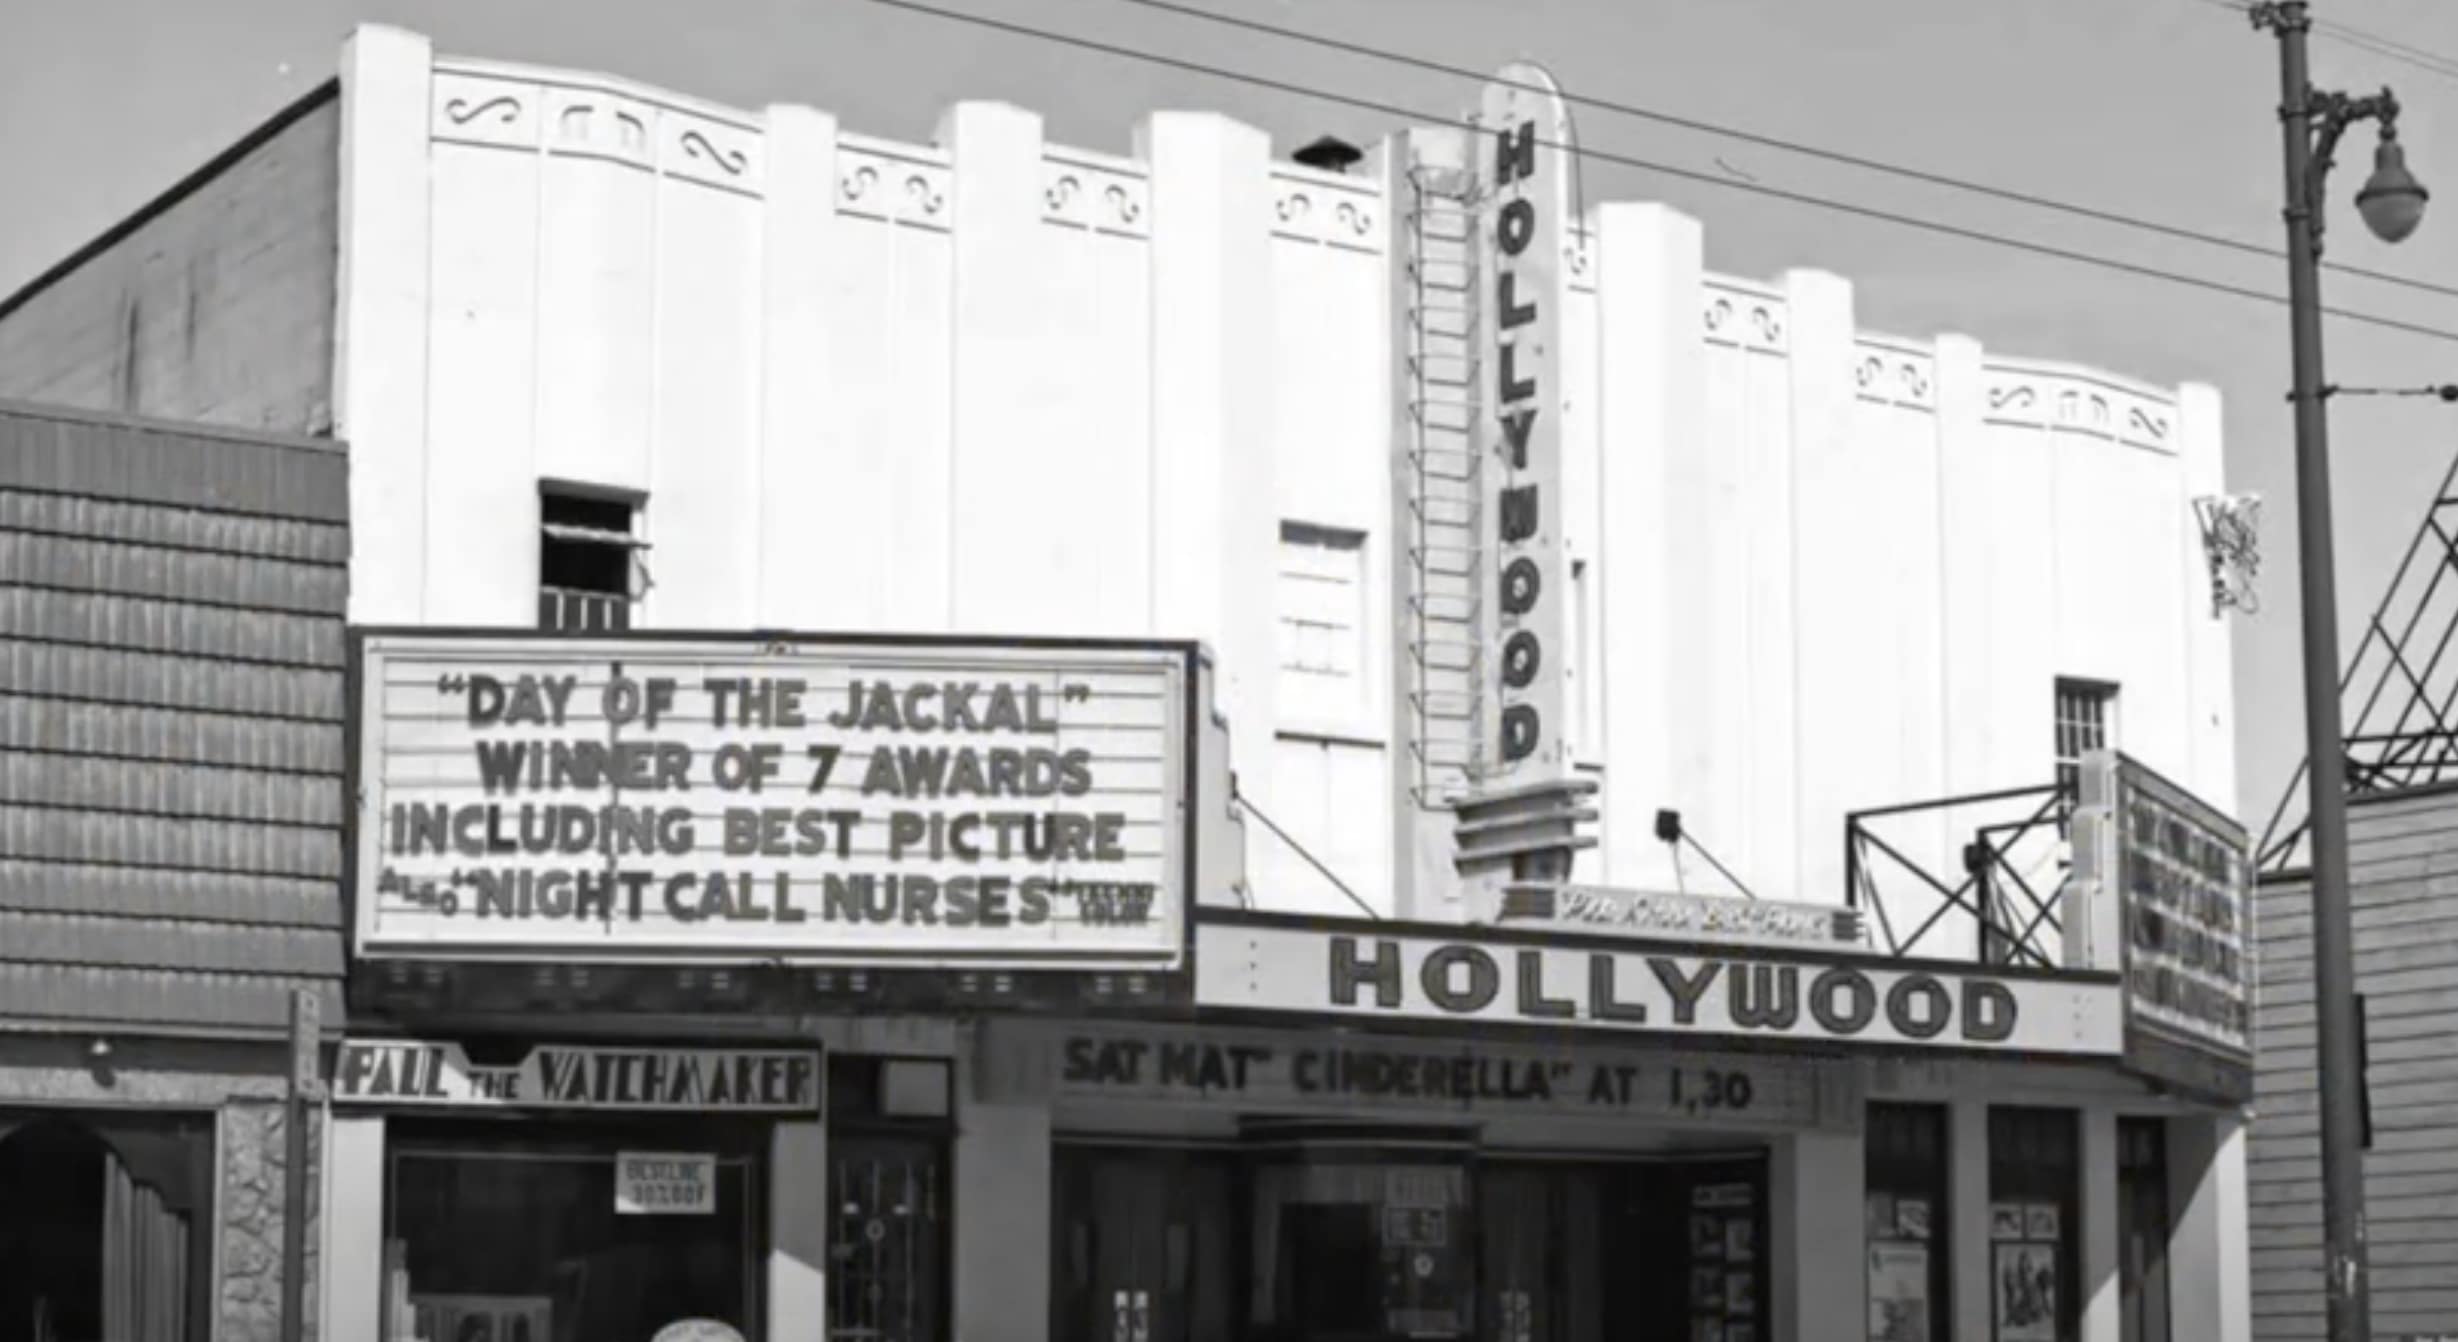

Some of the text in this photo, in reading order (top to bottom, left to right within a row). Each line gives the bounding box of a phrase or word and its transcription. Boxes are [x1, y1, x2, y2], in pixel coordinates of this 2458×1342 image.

[1496, 120, 1540, 762] HOLLYWOOD
[437, 673, 1090, 733] "DAY OF THE JACKAL"
[476, 740, 1093, 798] WINNER OF 7 AWARDS
[391, 802, 1126, 863] INCLUDING BEST PICTURE
[451, 866, 653, 922] "NIGHT
[663, 871, 807, 923] CALL
[1329, 935, 2018, 1042] HOLLYWOOD
[345, 1046, 811, 1103] PAUL THE WATCHMAKER
[1063, 1036, 1147, 1085] SAT
[1588, 1064, 1638, 1105] AT
